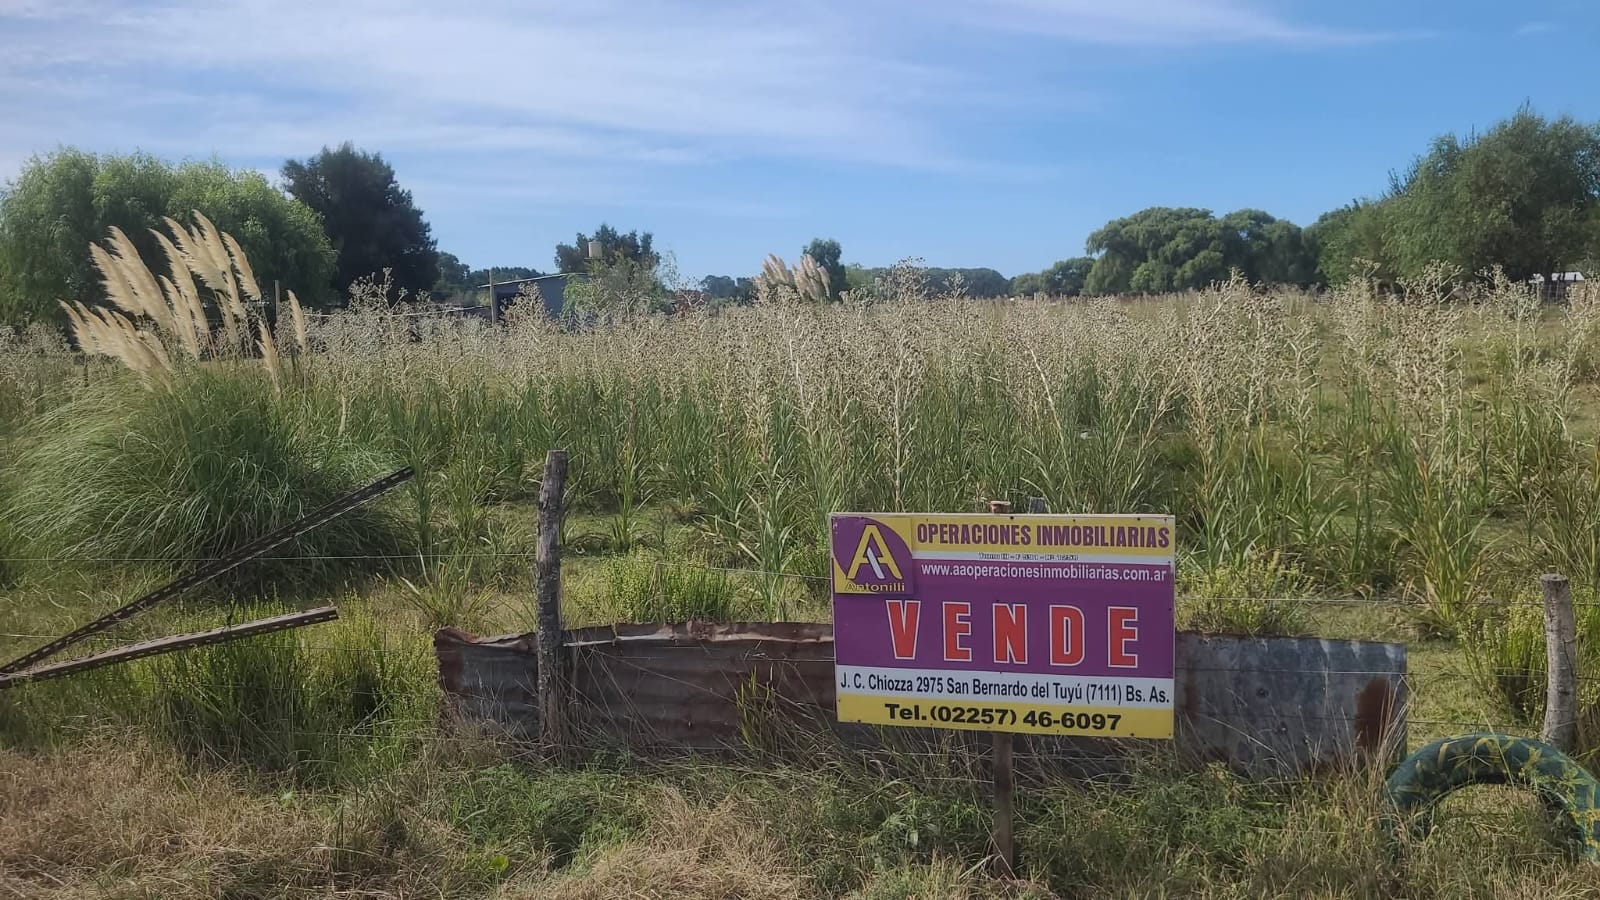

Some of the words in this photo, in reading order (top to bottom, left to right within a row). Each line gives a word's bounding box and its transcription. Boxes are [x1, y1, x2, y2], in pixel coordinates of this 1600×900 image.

[917, 523, 1031, 546] OPERACIONES
[1036, 525, 1170, 548] INMOBILIARIAS
[921, 563, 1167, 582] www.aaoperacionesinmobiliarias.com.ar
[845, 582, 905, 592] Antonilli
[886, 600, 1138, 669] VENDE
[840, 672, 850, 688] J.
[853, 673, 865, 690] C.
[868, 674, 913, 692] Chiozza
[916, 676, 944, 694] 2975
[947, 677, 969, 695] San
[973, 678, 1028, 697] Bernardo
[1031, 681, 1049, 699] del
[1053, 682, 1082, 703] Tuyú
[1086, 683, 1122, 705] (7111)
[1126, 685, 1146, 702] Bs.
[1149, 686, 1170, 703] As.
[1023, 710, 1121, 731] 46-6097
